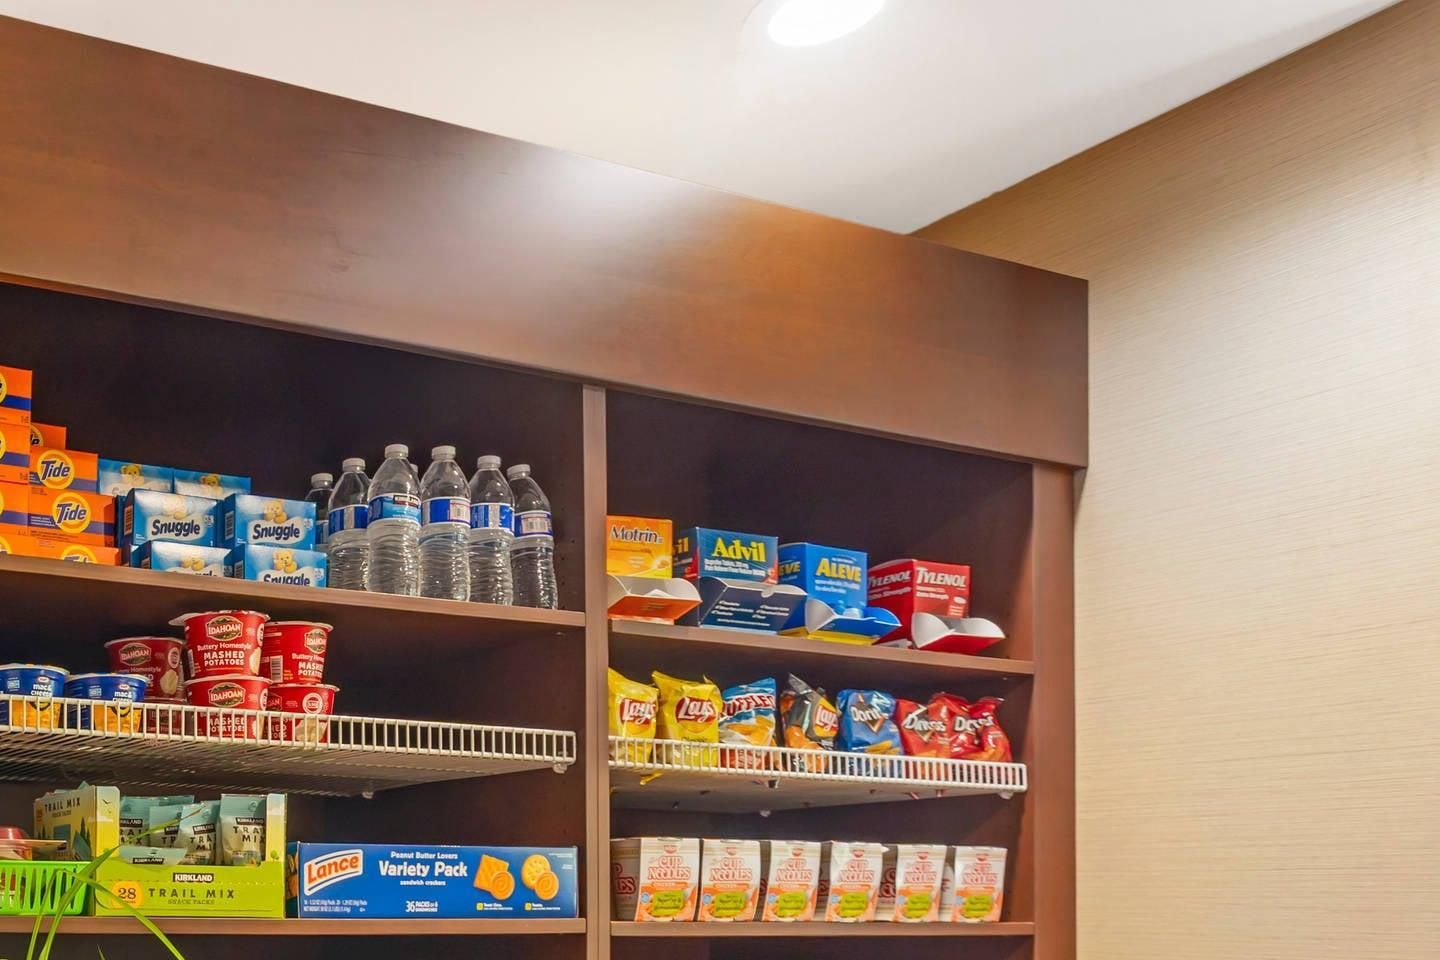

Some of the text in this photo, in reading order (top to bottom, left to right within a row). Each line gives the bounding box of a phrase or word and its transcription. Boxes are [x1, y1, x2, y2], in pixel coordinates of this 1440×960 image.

[41, 460, 71, 480] Tide
[57, 503, 86, 523] Tide
[151, 519, 201, 537] Snuggle
[253, 524, 301, 540] Snuggle
[612, 526, 657, 543] Motrin
[712, 537, 766, 562] Advil
[779, 561, 800, 576] EVE
[816, 558, 861, 582] ALEVE
[917, 567, 966, 588] TYLENOL
[208, 623, 241, 635] IDAHOAN
[204, 651, 245, 659] MASHED
[210, 690, 243, 701] IDAHOAN
[44, 798, 81, 812] TRAIL MIX
[391, 851, 414, 859] Peanut
[660, 856, 682, 867] CUP
[308, 855, 359, 884] Lance
[379, 861, 467, 877] Variety Pack
[721, 857, 744, 869] CUP
[786, 858, 807, 870] CUP
[847, 860, 868, 871] CUP
[648, 867, 691, 881] NOODLES
[711, 868, 752, 882] NOODLES
[776, 869, 812, 882] NOODLES
[839, 871, 874, 883] NOODLES
[118, 888, 136, 899] 28
[148, 888, 235, 898] TRAIL MIX
[405, 901, 415, 912] 36
